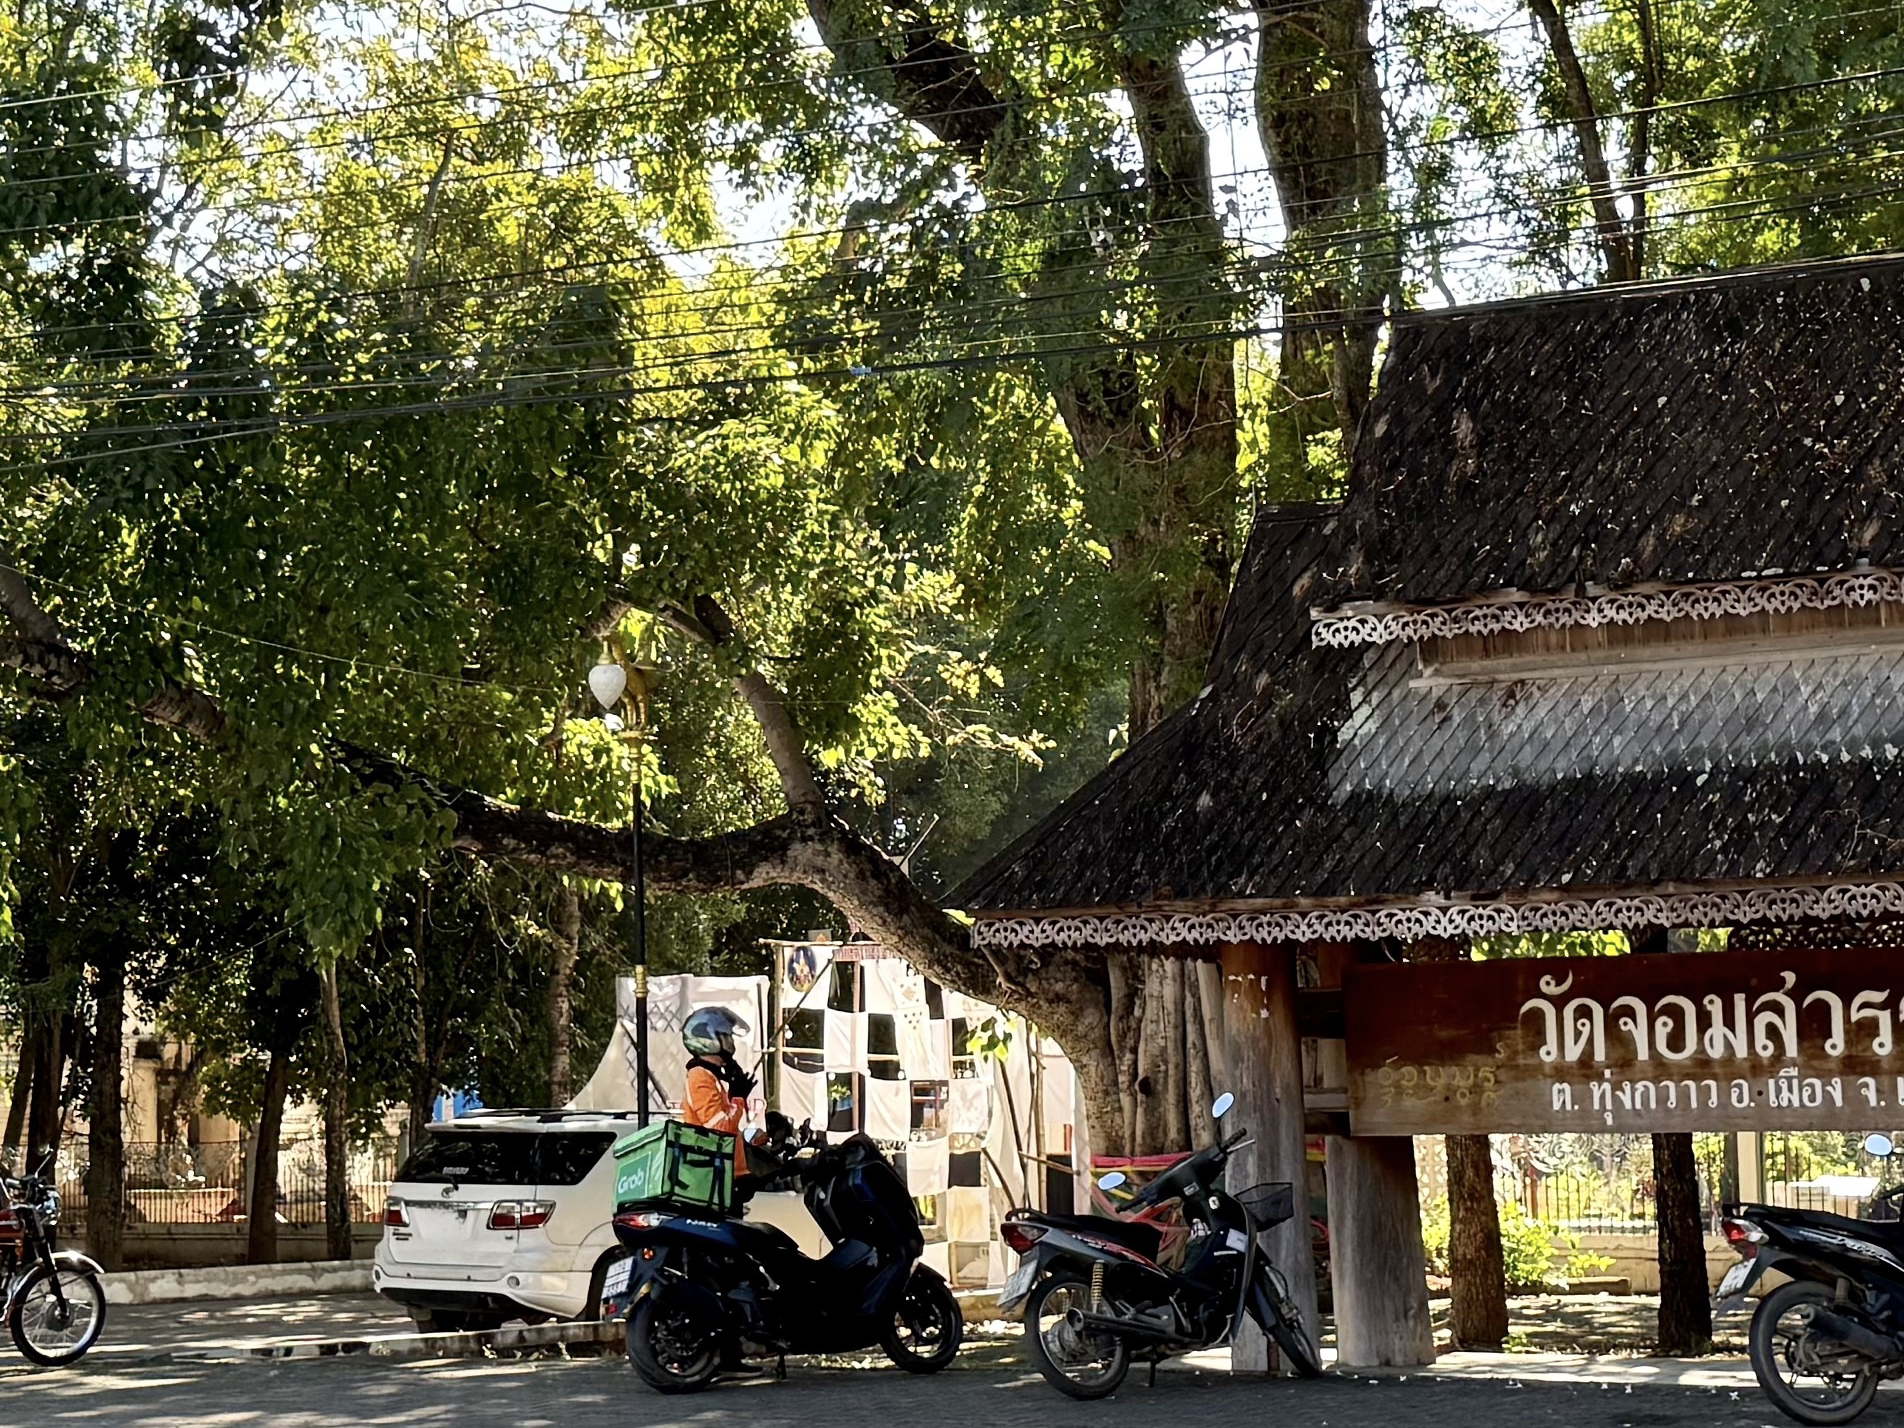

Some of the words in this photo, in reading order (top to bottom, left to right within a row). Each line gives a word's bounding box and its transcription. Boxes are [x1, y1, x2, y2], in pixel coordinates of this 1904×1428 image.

[1551, 1080, 1580, 1111] ต.
[1589, 1068, 1718, 1126] ทุ่งกวาว
[1730, 1078, 1756, 1108] อ.
[1767, 1066, 1844, 1109] เมือง
[1856, 1076, 1886, 1108] จ.
[617, 1168, 645, 1194] Grab
